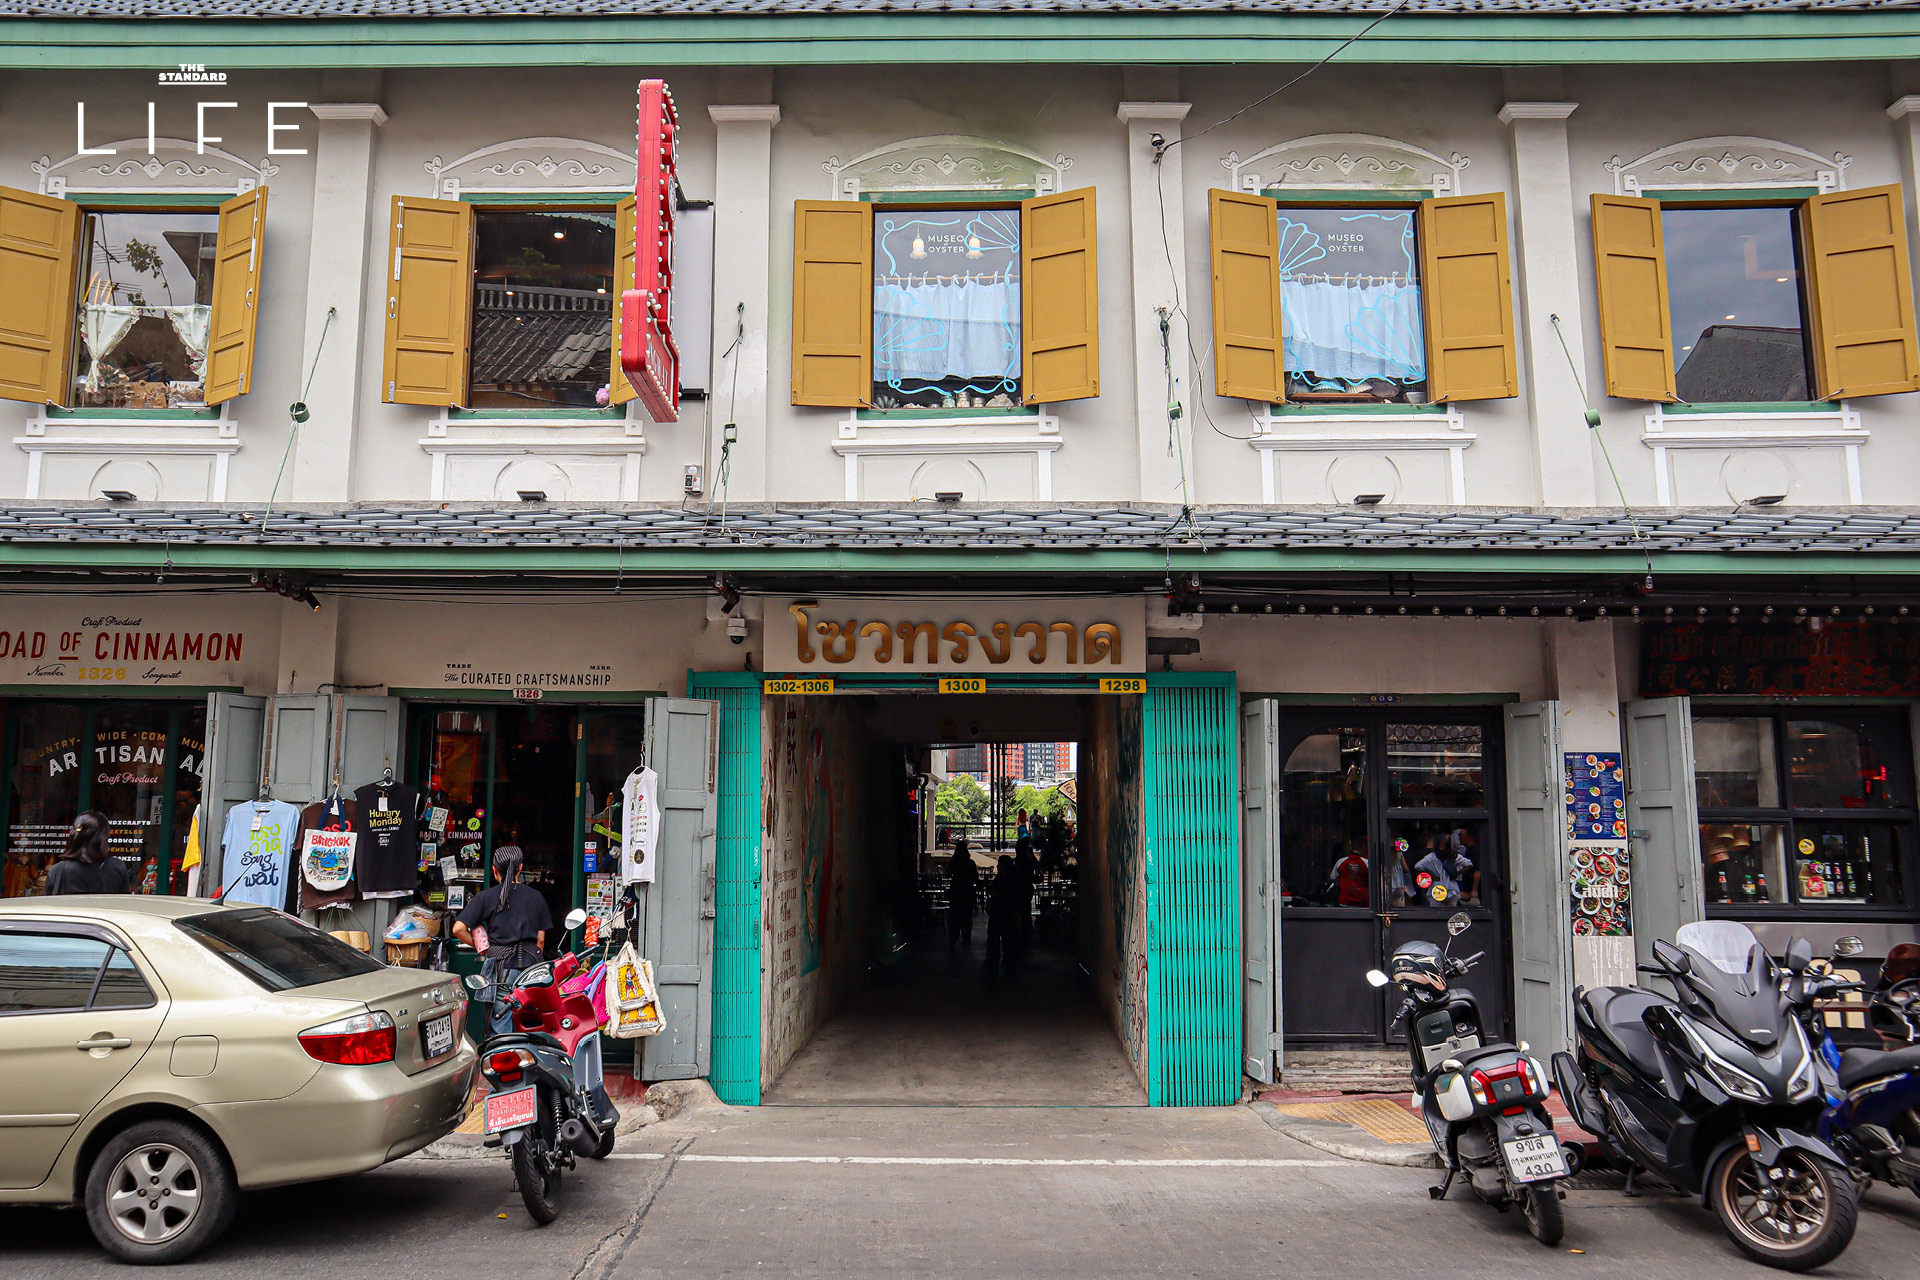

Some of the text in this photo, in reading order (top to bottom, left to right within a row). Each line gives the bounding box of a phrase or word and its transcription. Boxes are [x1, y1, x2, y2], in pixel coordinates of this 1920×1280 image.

[928, 235, 965, 243] MUSEO
[1328, 234, 1364, 242] MUSEO
[81, 616, 142, 628] Craft Product
[789, 600, 1122, 664] โซวทรงวาด
[59, 632, 84, 652] OF
[95, 632, 244, 662] CINNAMON
[27, 664, 182, 684] Number 1326 Songwat
[461, 672, 511, 685] CURATED
[516, 673, 611, 686] CRAFTSMANSHIP
[768, 681, 830, 692] 1302-1306
[944, 680, 980, 691] 1300
[1106, 680, 1141, 691] 1298
[515, 689, 539, 699] 1326
[97, 731, 127, 741] WIDE
[98, 772, 158, 785] Craft Product
[369, 809, 401, 819] Hungry
[369, 816, 402, 828] Monday
[447, 831, 483, 839] CINNAMON
[311, 835, 350, 848] BANGKOK
[1511, 1151, 1559, 1166] กรุงเทพมหานคร
[1525, 1162, 1553, 1176] 430
